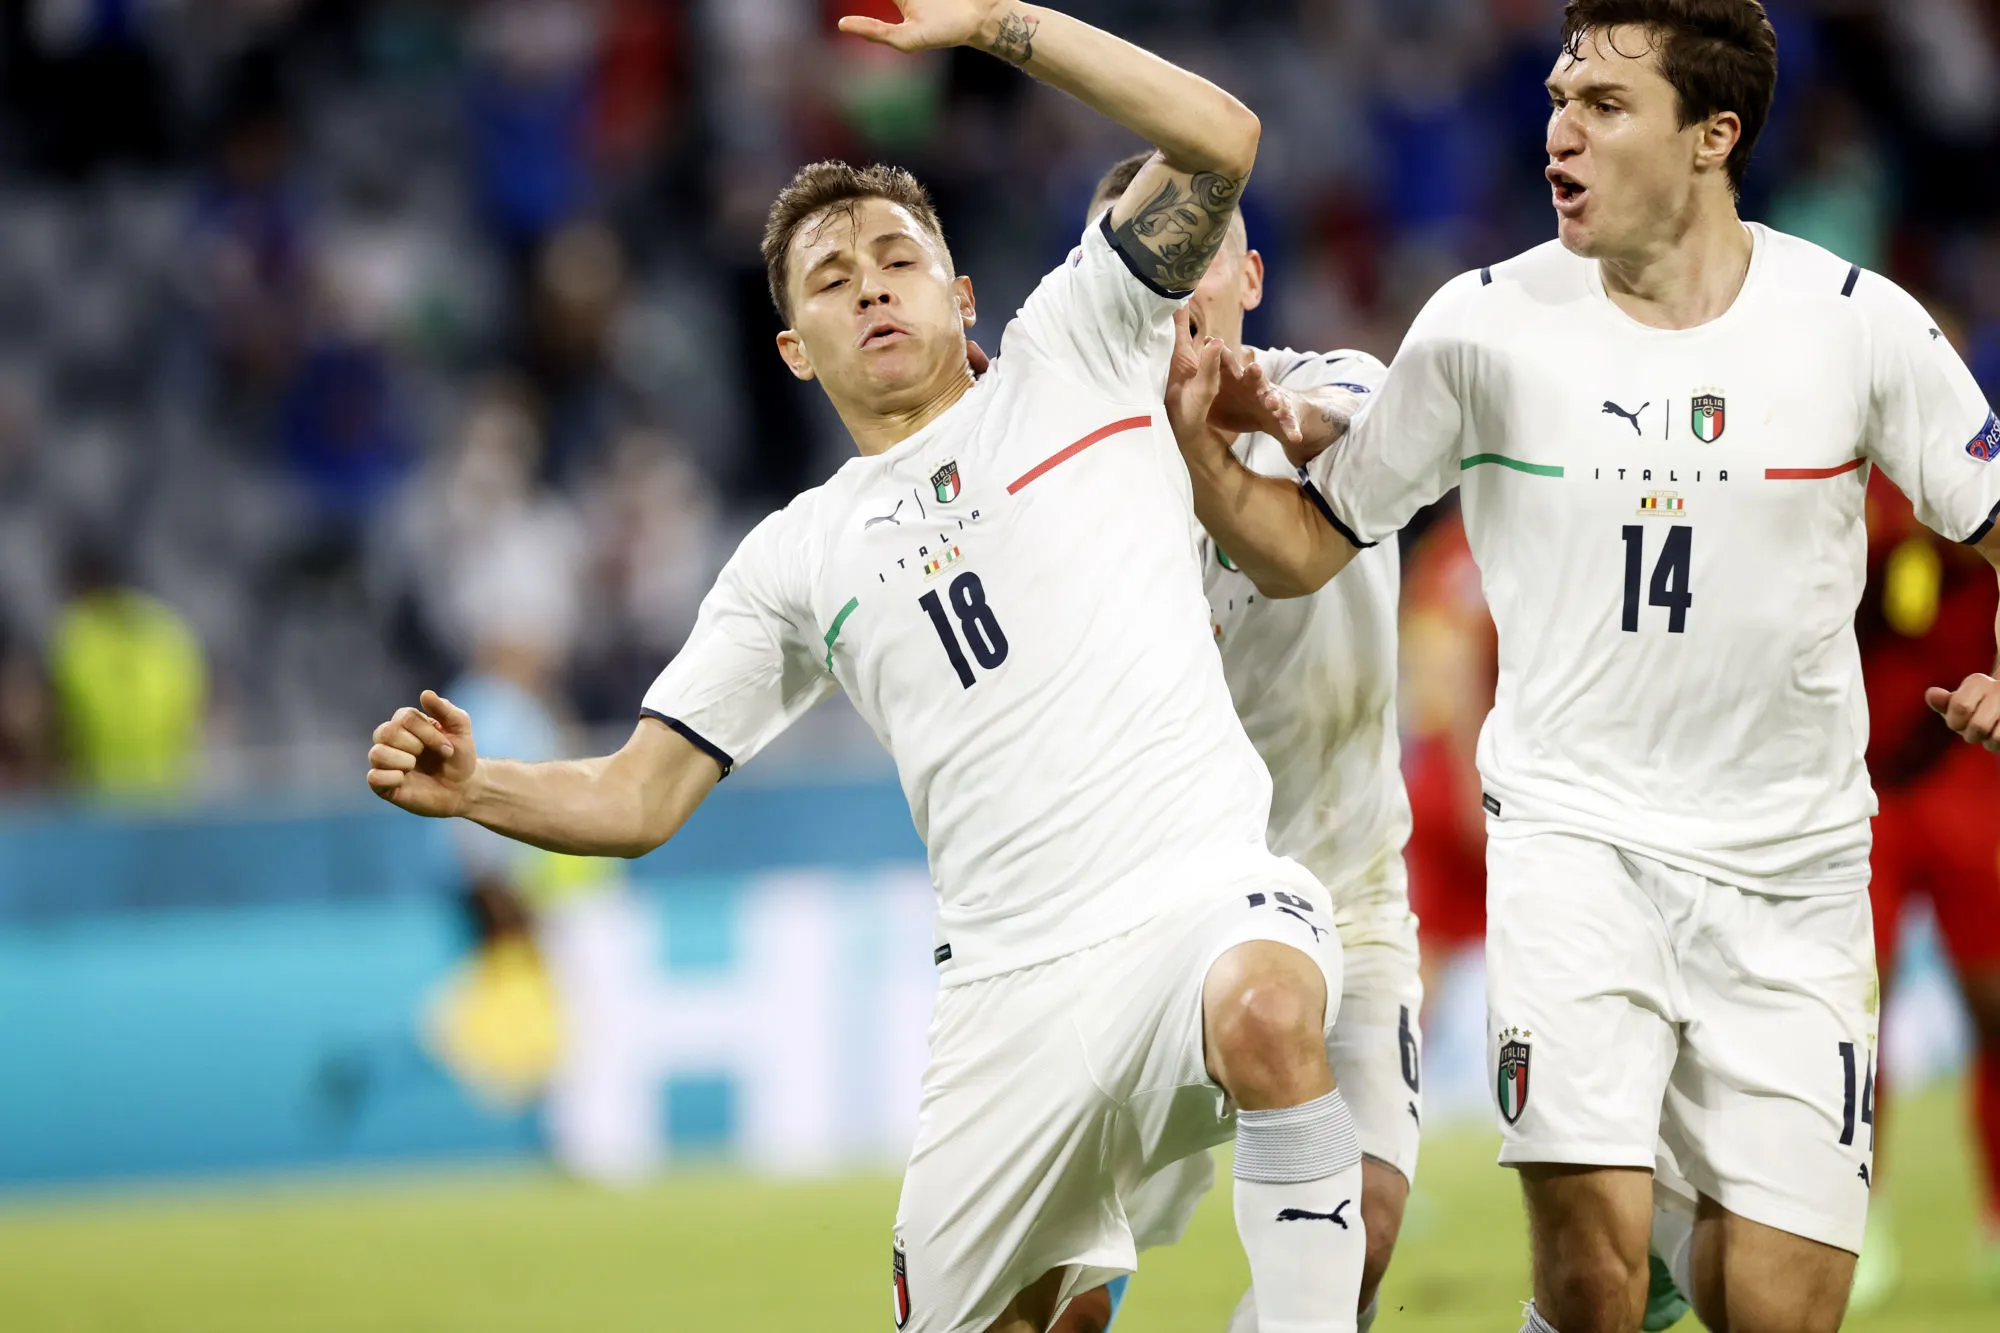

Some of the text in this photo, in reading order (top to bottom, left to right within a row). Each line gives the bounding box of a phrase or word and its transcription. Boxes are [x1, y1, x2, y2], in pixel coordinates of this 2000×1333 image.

[1694, 398, 1723, 407] ITALIA
[932, 463, 956, 484] ITALIA
[1595, 468, 1728, 482] ITALIA
[879, 509, 981, 583] ITALIA
[1621, 525, 1693, 634] 14
[918, 571, 1009, 690] 18
[1501, 1047, 1527, 1062] ITALIA
